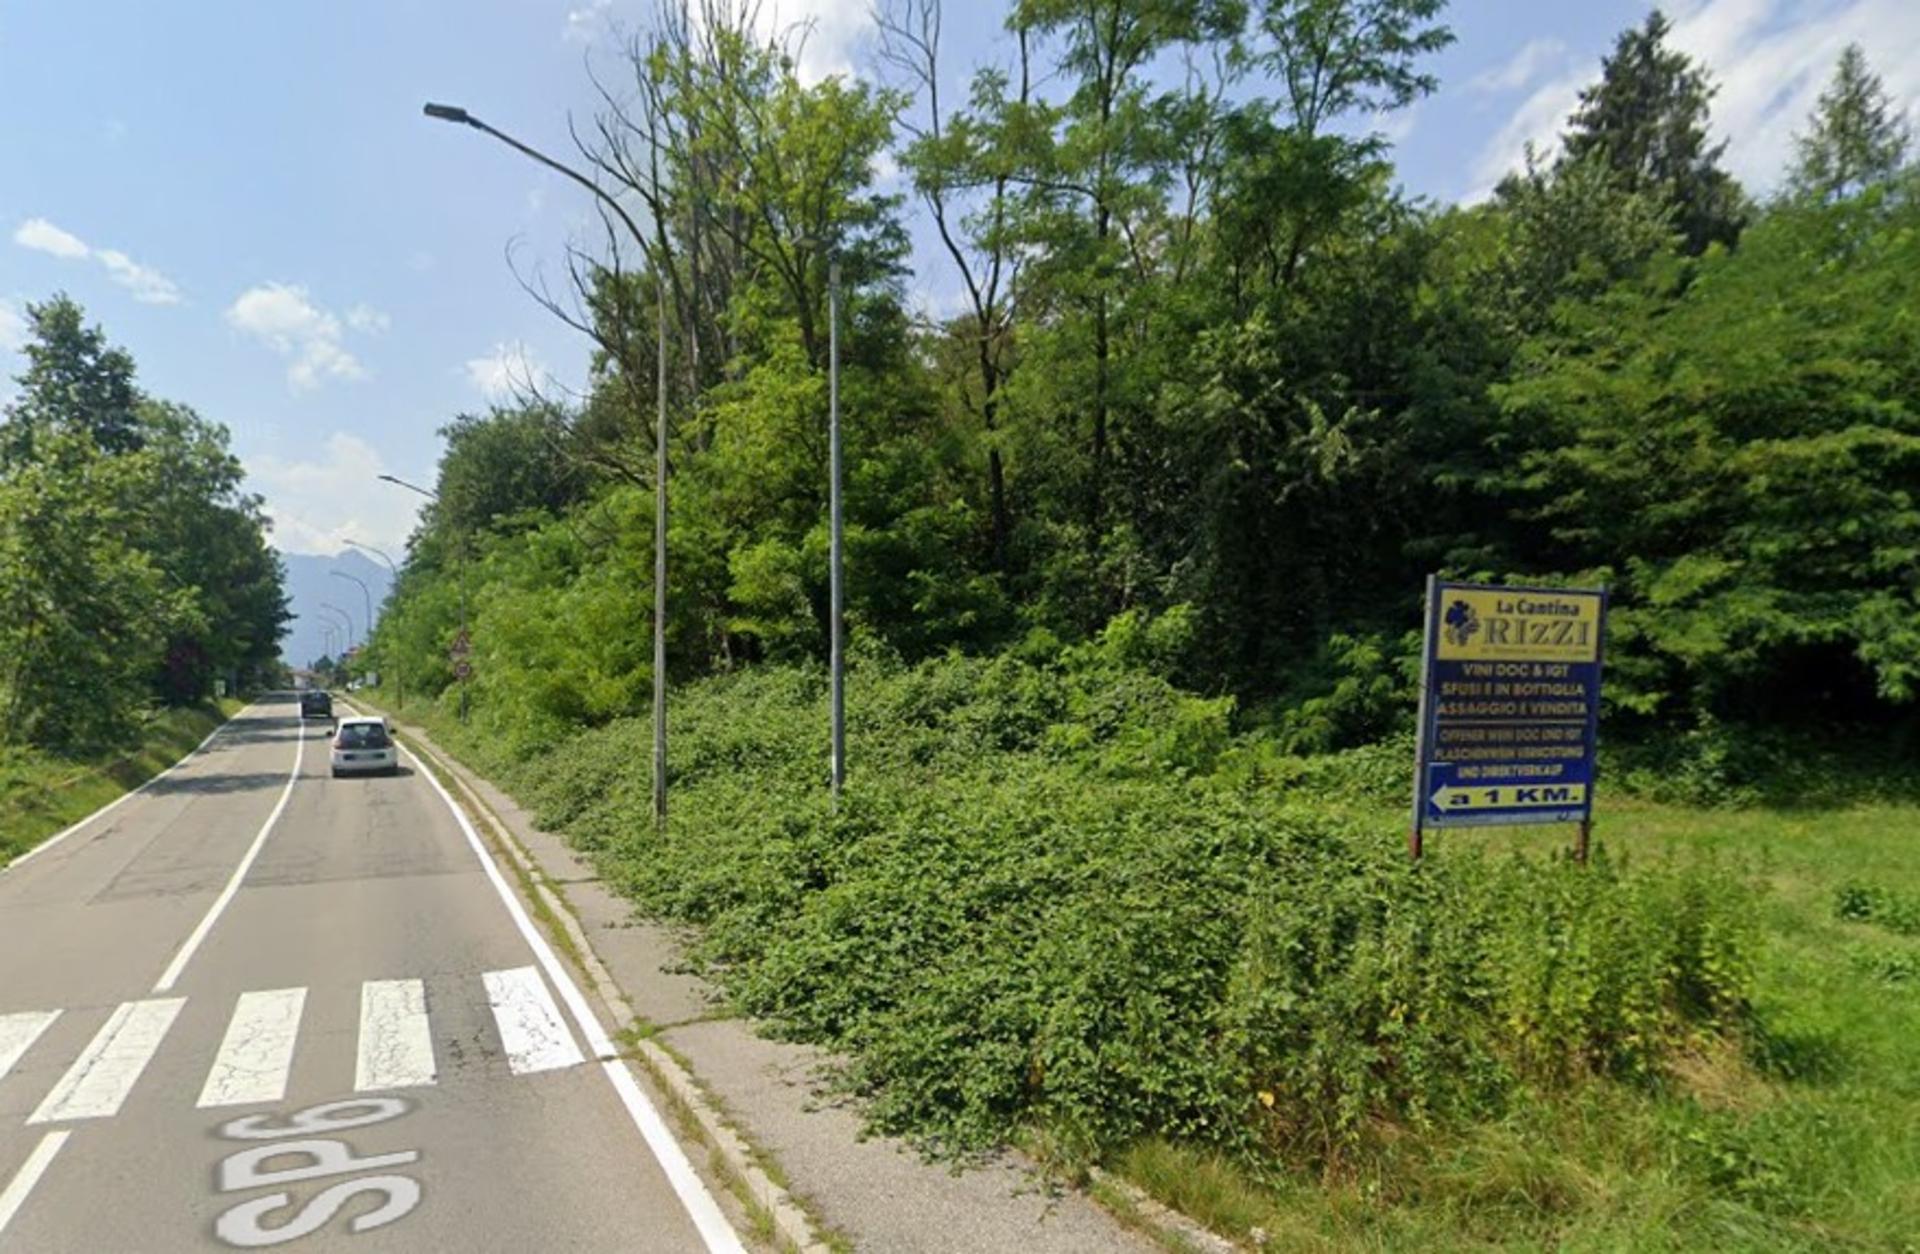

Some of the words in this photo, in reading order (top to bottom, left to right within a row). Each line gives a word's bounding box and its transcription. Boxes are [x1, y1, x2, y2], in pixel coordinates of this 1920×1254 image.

[1497, 600, 1514, 614] La
[1517, 600, 1580, 616] Cantina
[1463, 664, 1493, 676] VINI
[1496, 664, 1529, 677] DOC
[1494, 683, 1510, 696] IN
[1512, 683, 1586, 696] BOTTIGLIA
[1437, 702, 1518, 715] ASSAGGIO
[1530, 702, 1588, 715] VENDITA
[1450, 794, 1469, 805] a
[1484, 790, 1500, 803] 1
[1516, 788, 1579, 803] KM.
